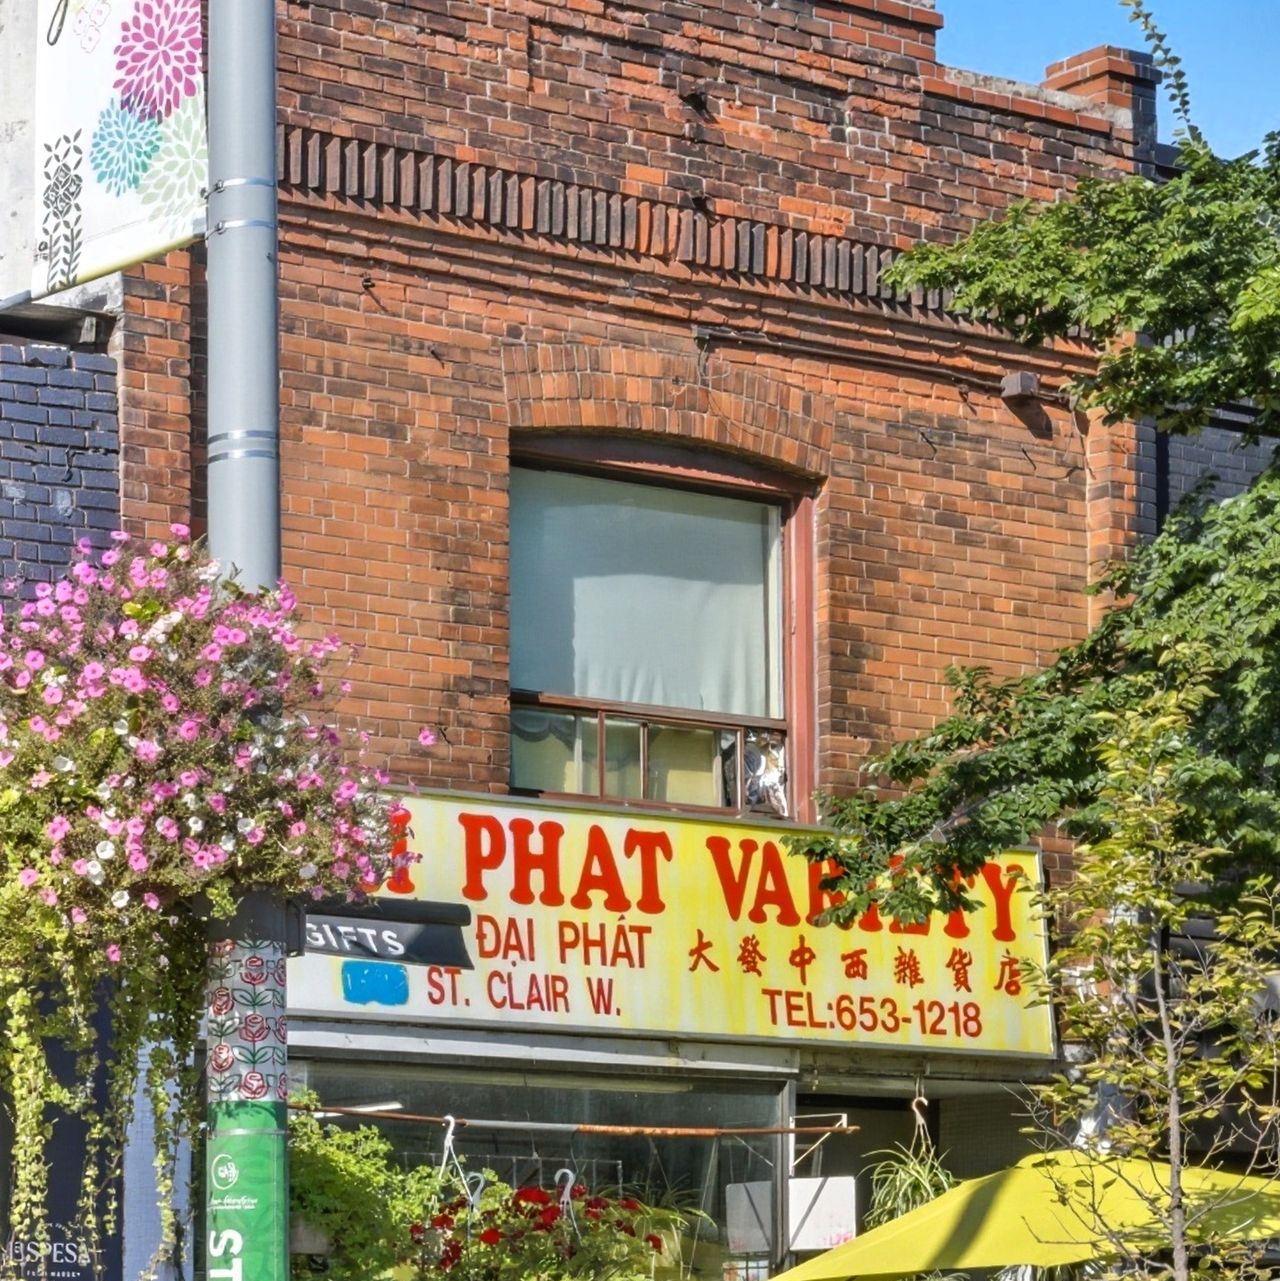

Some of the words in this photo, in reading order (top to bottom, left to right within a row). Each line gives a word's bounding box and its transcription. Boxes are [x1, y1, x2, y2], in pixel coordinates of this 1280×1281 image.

[458, 812, 673, 915] PHAT
[306, 922, 405, 955] GIFTS
[427, 965, 470, 1007] ST.
[486, 970, 570, 1013] CLAIR
[586, 977, 621, 1017] W.
[761, 988, 983, 1038] TEL:653-1218
